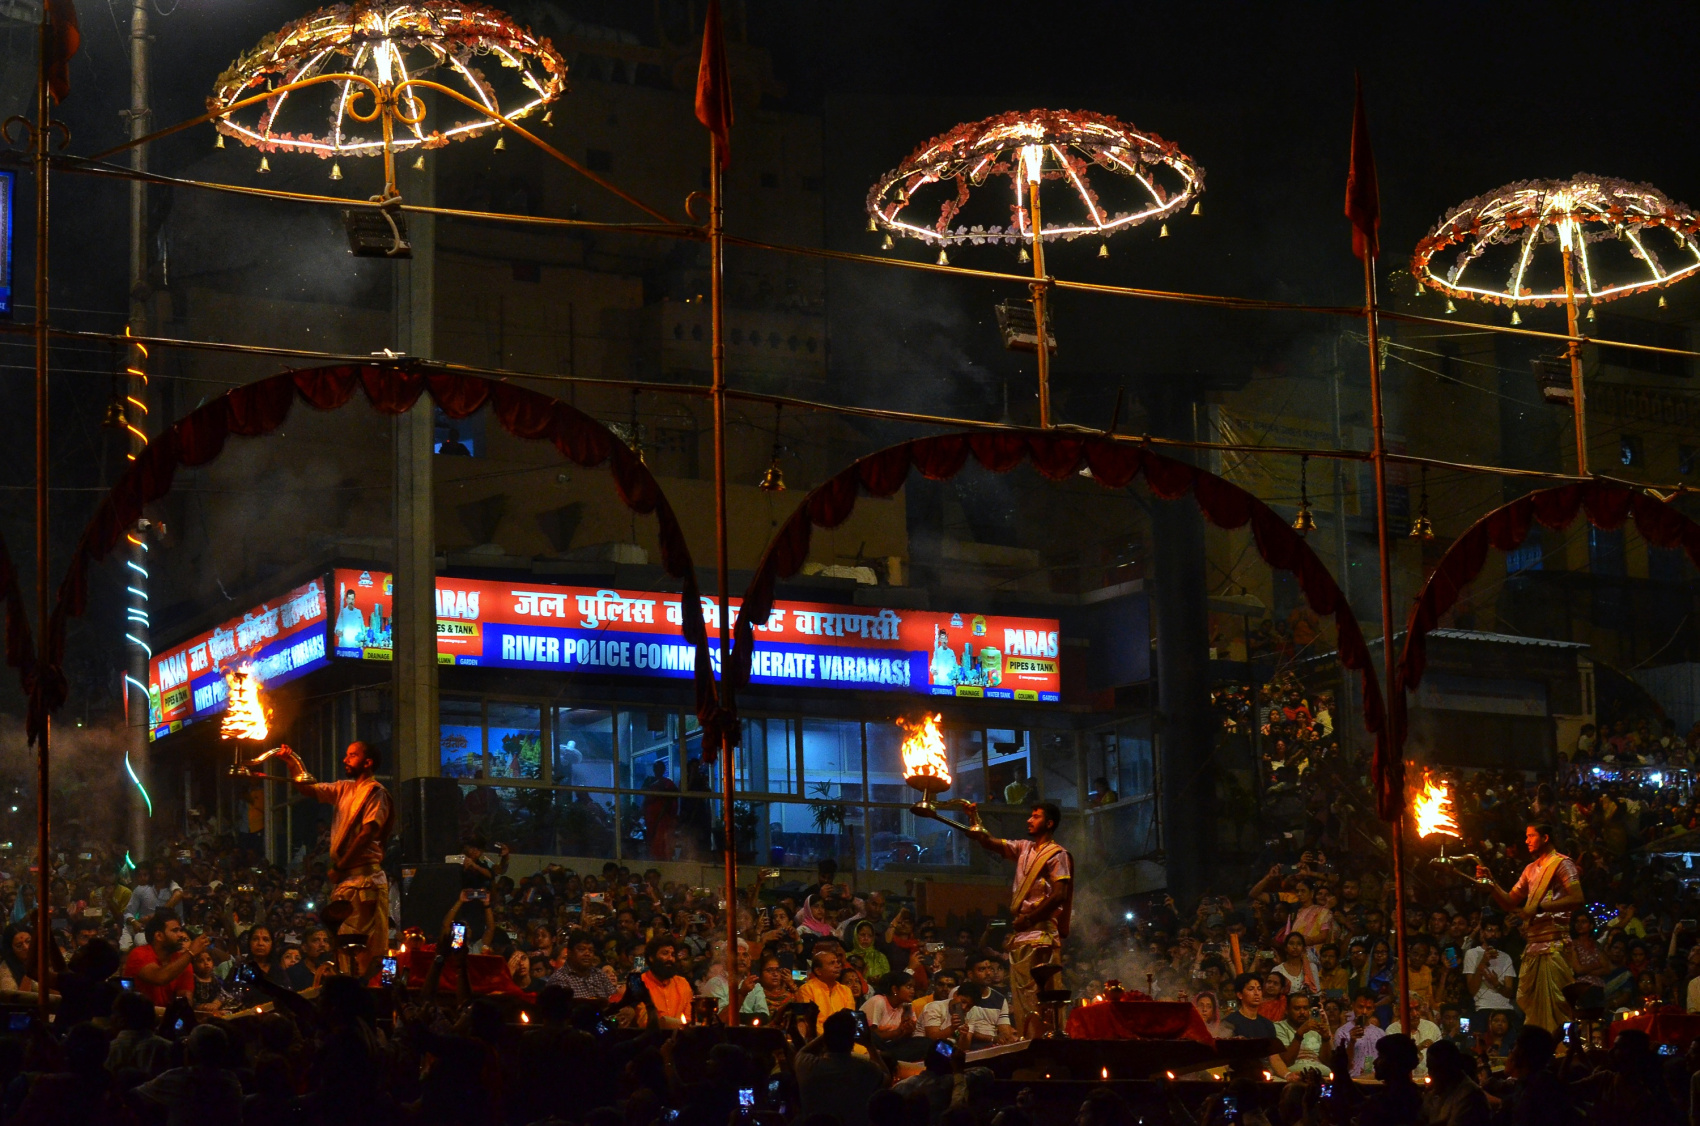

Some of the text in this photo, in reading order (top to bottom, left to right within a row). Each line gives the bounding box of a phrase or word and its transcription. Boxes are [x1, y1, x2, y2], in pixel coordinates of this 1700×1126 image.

[435, 589, 480, 620] ARAS
[511, 590, 568, 618] जल
[575, 589, 656, 629] पुलिस
[793, 608, 901, 640] वाराणसी
[447, 624, 454, 634] &
[454, 624, 474, 635] TANK
[1004, 628, 1059, 659] PARAS
[158, 650, 188, 692] PARAS
[188, 641, 209, 672] जल
[367, 652, 390, 660] DRAINAGE
[460, 658, 478, 666] GARDEN
[502, 634, 559, 663] RIVER
[564, 638, 630, 667] POLICE
[818, 655, 911, 687] VARANASI
[1009, 661, 1054, 672] PIPES & TANK
